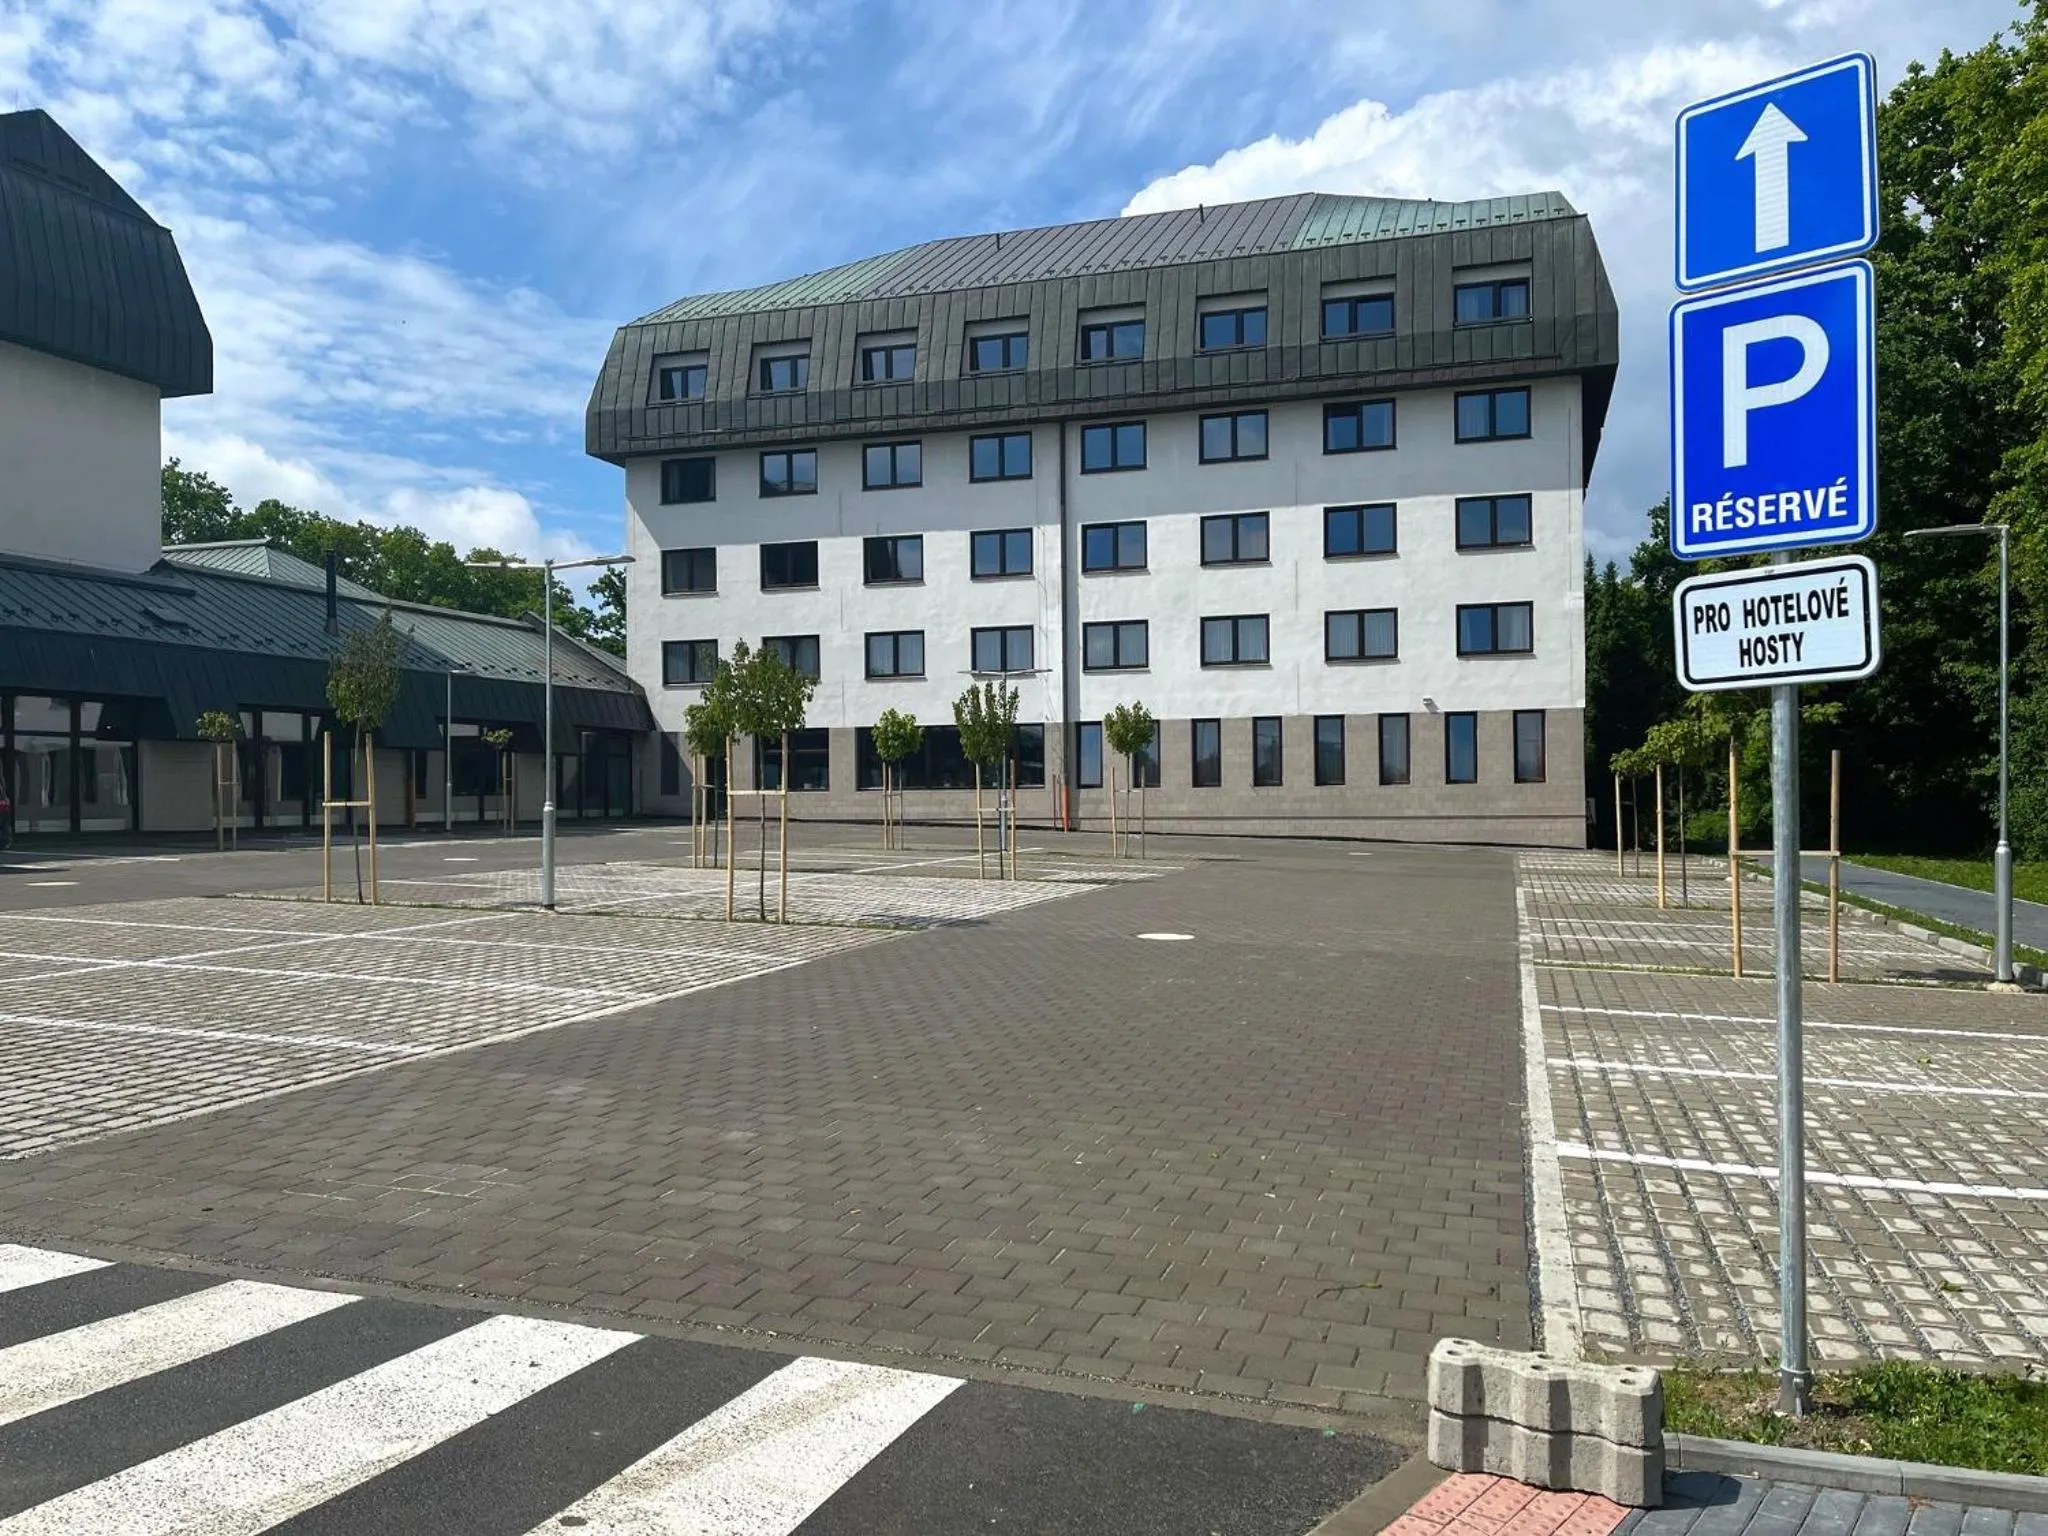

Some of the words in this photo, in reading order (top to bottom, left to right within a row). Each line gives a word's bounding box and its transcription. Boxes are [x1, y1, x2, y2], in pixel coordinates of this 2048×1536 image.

[1723, 315, 1830, 469] P
[1692, 477, 1848, 533] RÉSERVÉ
[1694, 602, 1731, 634] PRO
[1743, 577, 1849, 628] HOTELOVÉ
[1739, 631, 1804, 667] HOSTY
